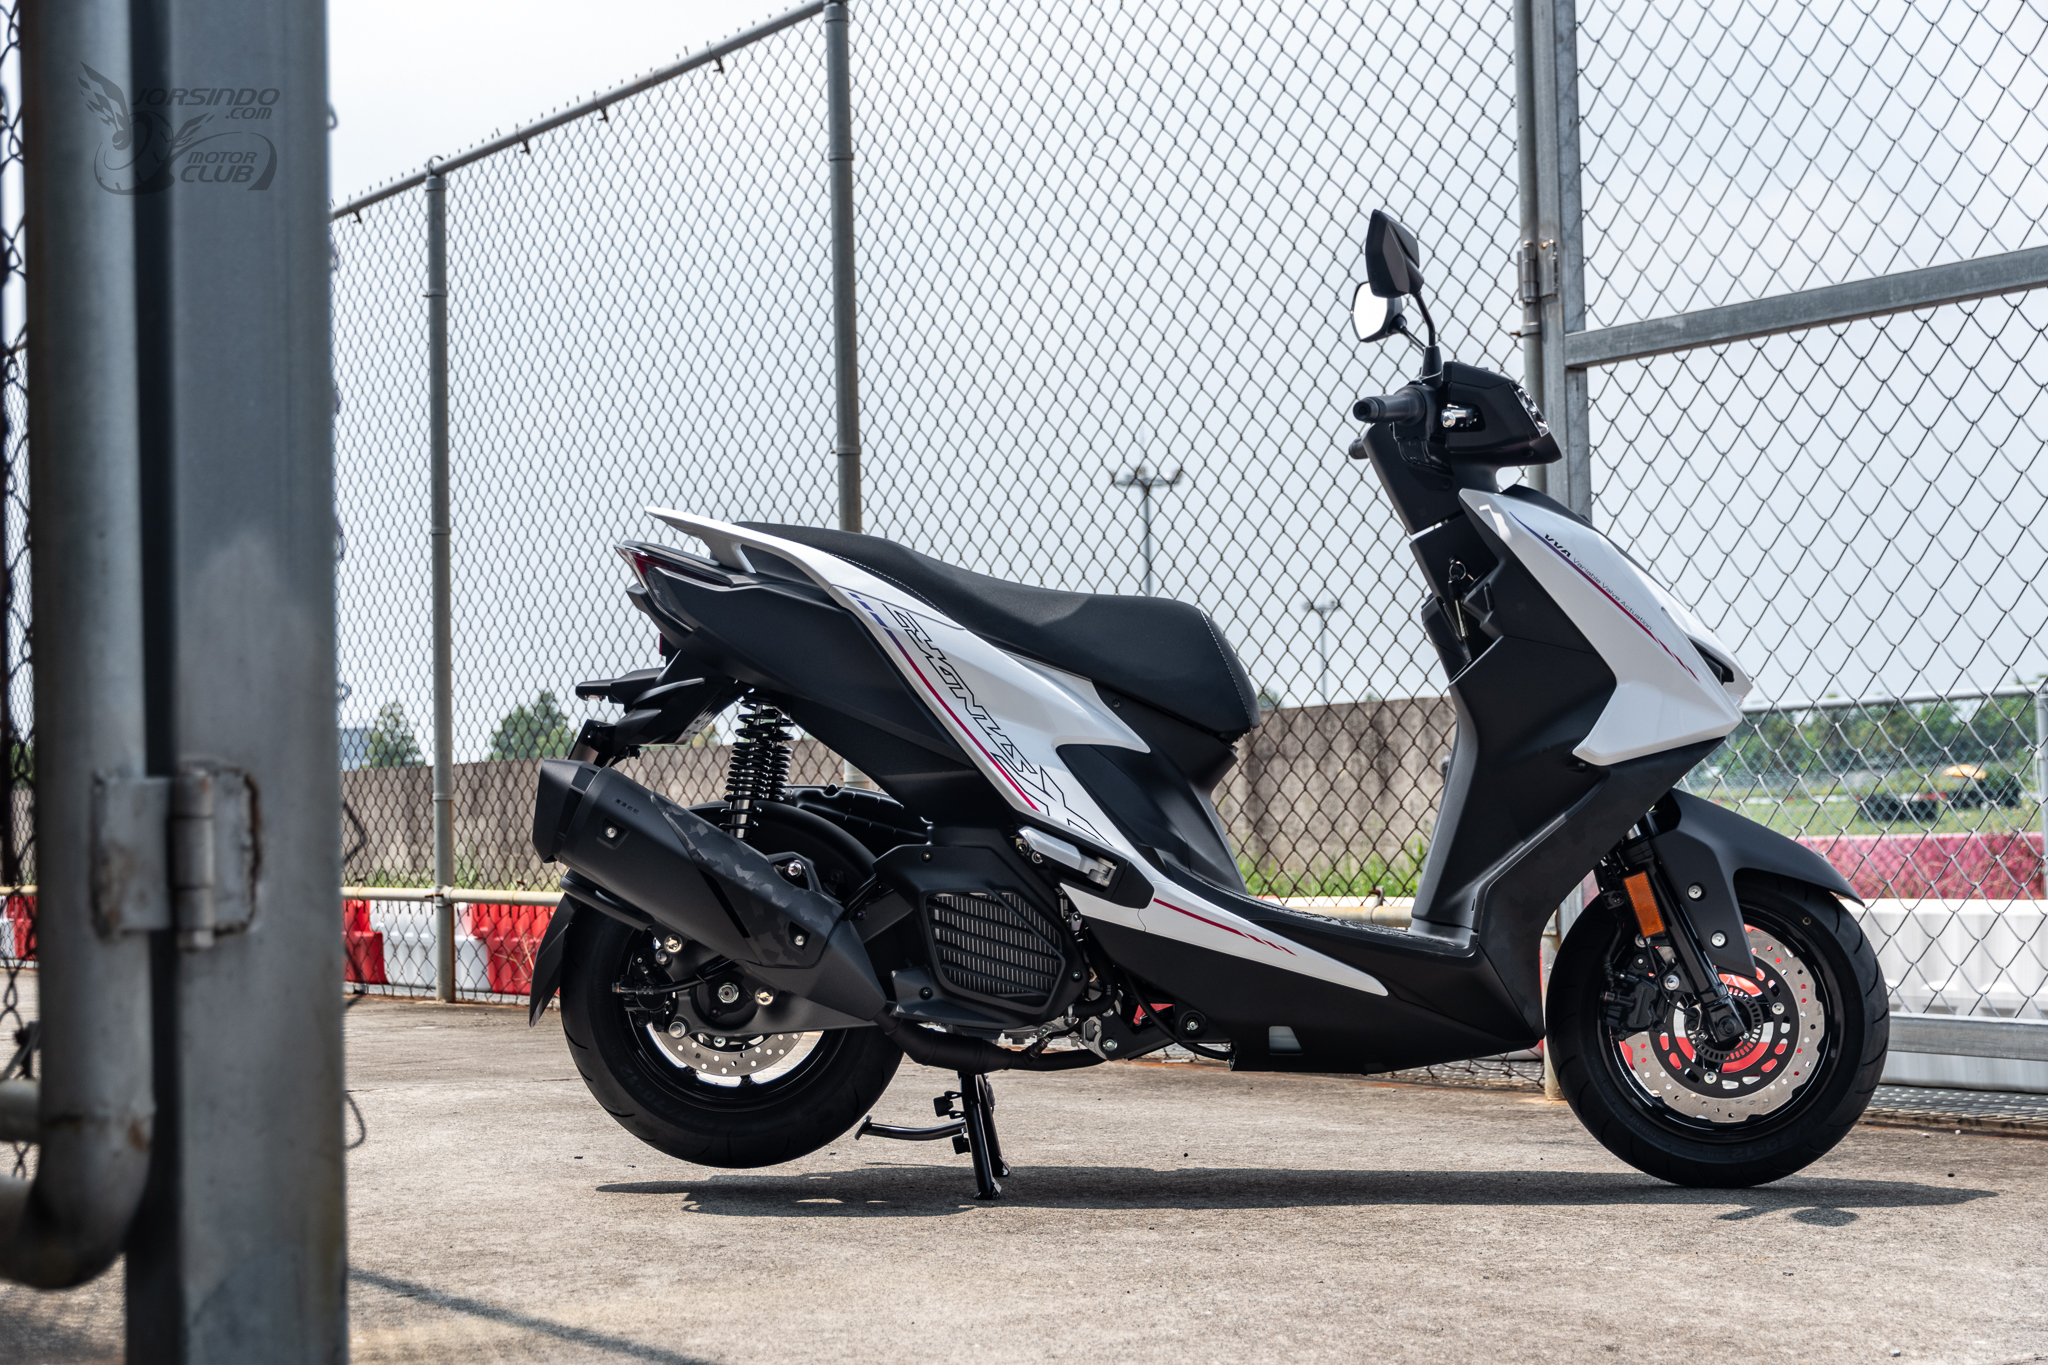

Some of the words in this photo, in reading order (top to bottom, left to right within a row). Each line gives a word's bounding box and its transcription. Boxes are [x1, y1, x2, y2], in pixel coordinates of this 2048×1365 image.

[1545, 534, 1571, 557] VVA
[1573, 557, 1601, 585] Variable
[1602, 582, 1621, 602] Valve
[1620, 601, 1652, 630] Actuation
